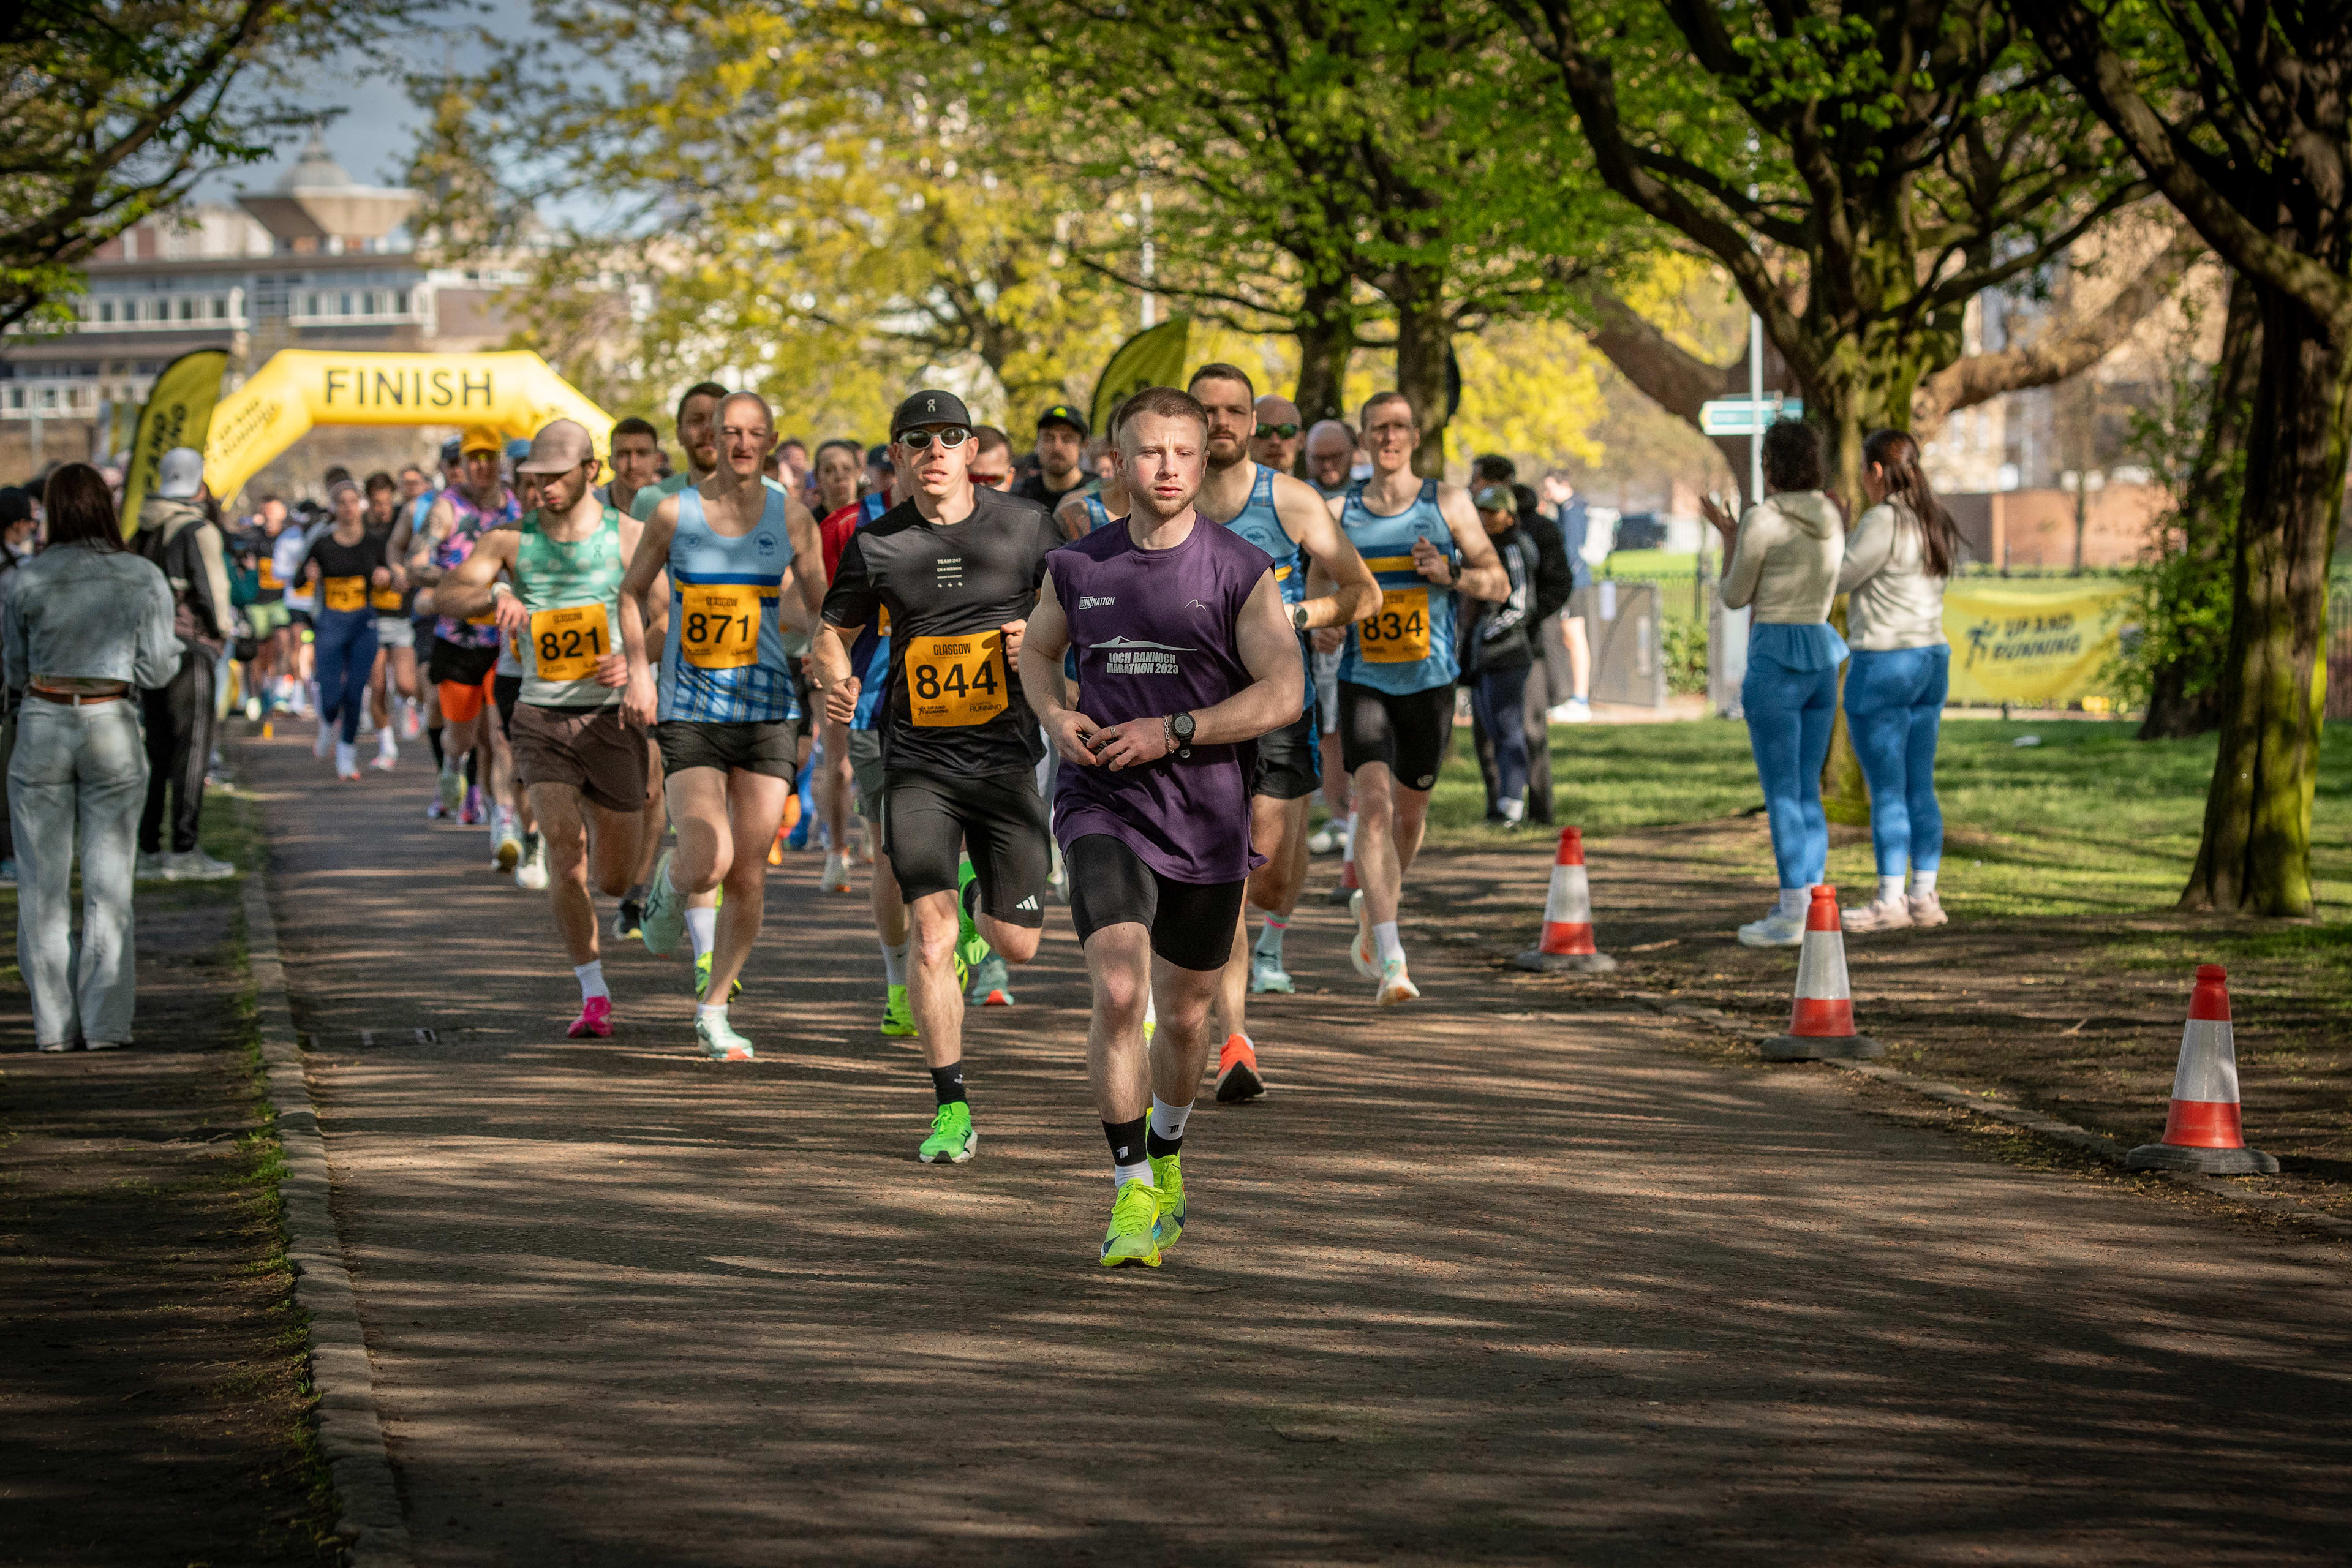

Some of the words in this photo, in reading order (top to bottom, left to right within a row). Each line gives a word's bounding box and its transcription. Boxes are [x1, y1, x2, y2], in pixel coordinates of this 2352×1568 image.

[327, 369, 490, 406] FINISH
[687, 613, 748, 643] 871
[1363, 611, 1423, 641] 834
[541, 627, 600, 660] 821
[933, 643, 970, 655] GLASGOW
[1109, 652, 1131, 663] LOCH
[1133, 652, 1175, 663] RANNOCH
[916, 660, 998, 699] 844
[1106, 663, 1154, 674] MARATHON
[1155, 663, 1179, 674] 2023
